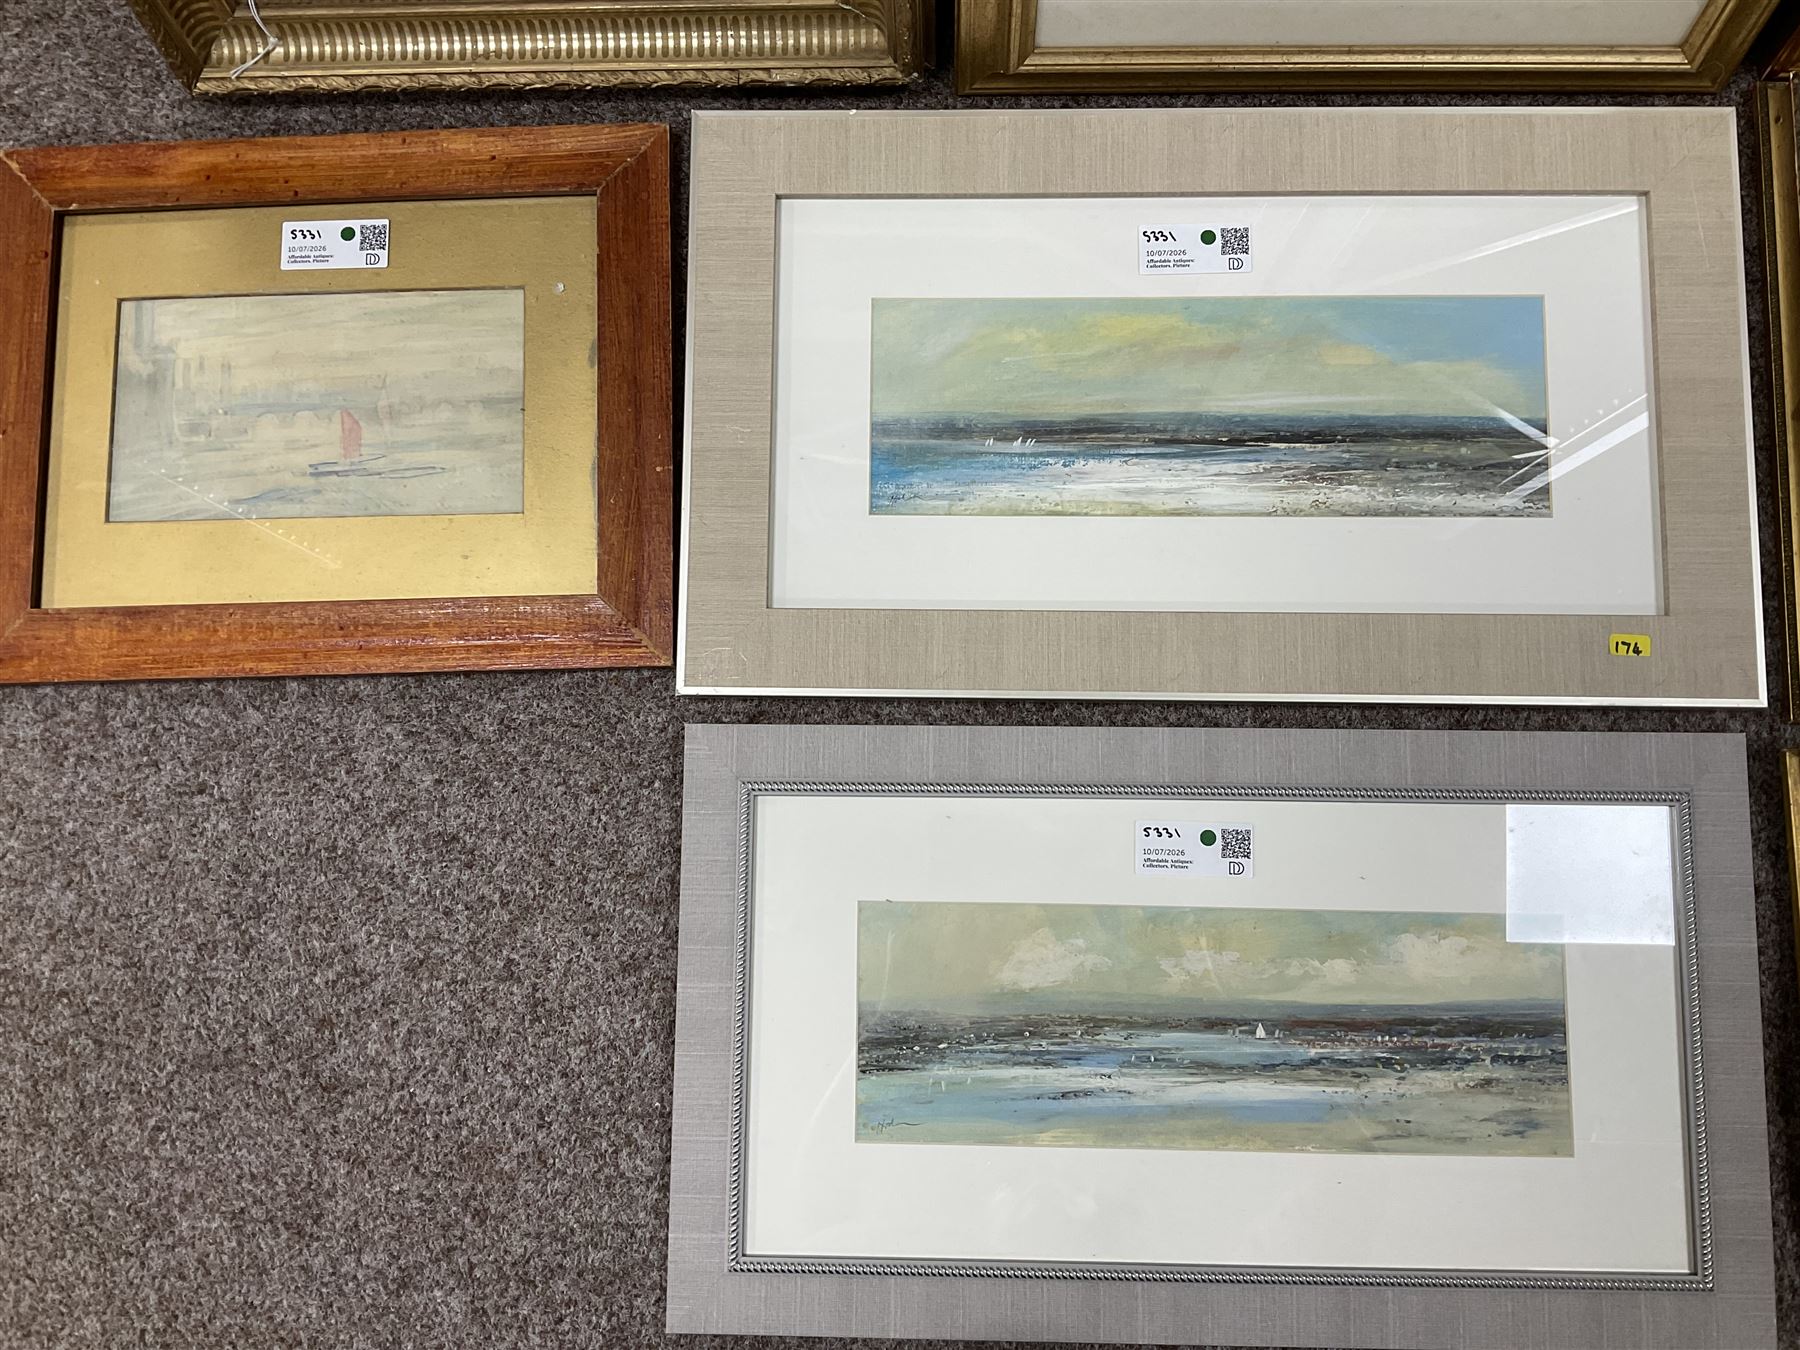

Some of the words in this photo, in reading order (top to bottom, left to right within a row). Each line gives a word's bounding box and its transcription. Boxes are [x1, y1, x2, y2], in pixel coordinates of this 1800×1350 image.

[290, 229, 322, 240] 5331
[1142, 230, 1177, 243] 5331
[288, 245, 328, 253] 10/07/2026
[1146, 249, 1187, 257] 10/07/2026
[1615, 640, 1643, 656] 174
[1143, 826, 1181, 838] 5331
[1142, 848, 1186, 856] 10/07/2026
